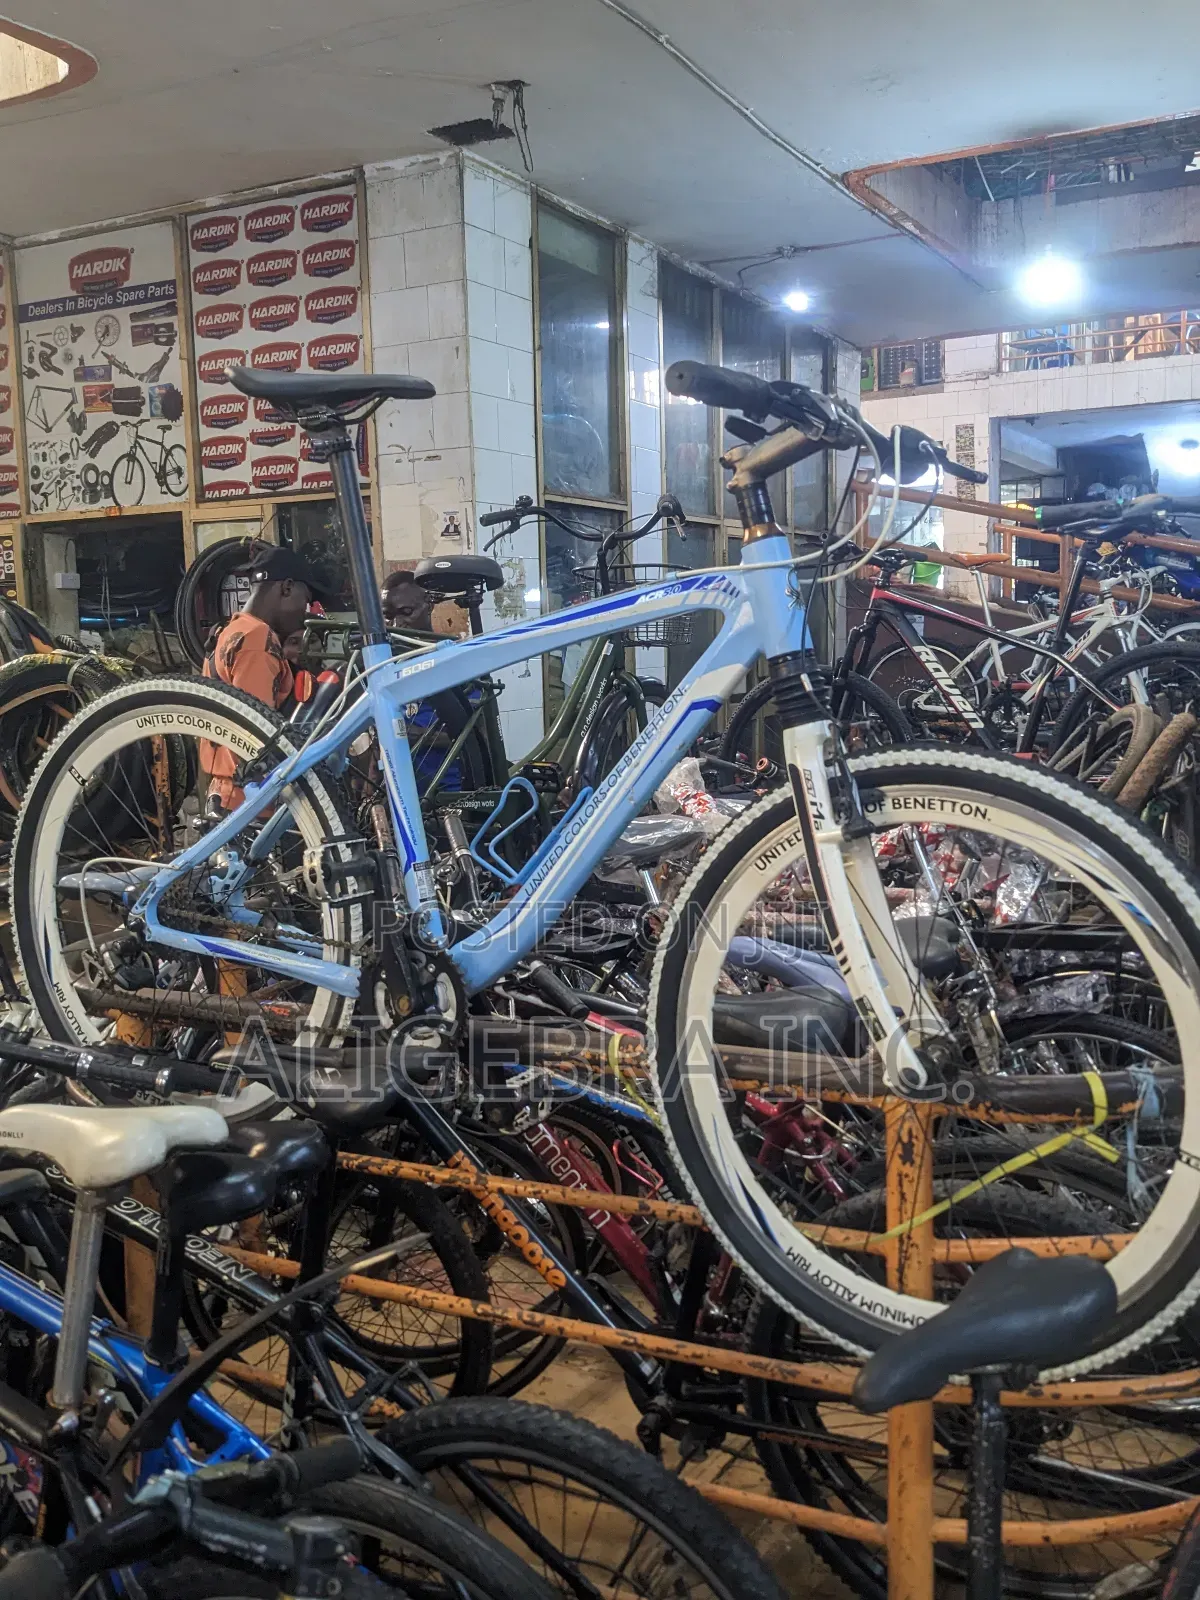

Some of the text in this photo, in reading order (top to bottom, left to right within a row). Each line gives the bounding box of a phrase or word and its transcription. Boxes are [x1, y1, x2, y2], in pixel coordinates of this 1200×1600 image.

[303, 201, 350, 220] HARDIK
[246, 212, 292, 231] HARDIK
[192, 222, 236, 241] HARDIK
[306, 246, 352, 265] HARDIK
[72, 256, 127, 279] HARDIK
[249, 256, 295, 274] HARDIK
[195, 266, 238, 284] HARDIK
[28, 283, 175, 317] Dealers In Bicycle Spare Parts
[308, 293, 354, 311] HARDIK
[197, 310, 240, 327] HARDIK
[251, 302, 296, 319] HARDIK
[254, 349, 299, 365] HARDIK
[310, 341, 356, 358] HARDIK
[200, 356, 243, 372] HARDIK
[203, 401, 246, 417] HARDIK
[201, 443, 244, 457] HARDIK
[0, 471, 19, 482] RDIK
[252, 463, 296, 477] HARDIK
[136, 714, 258, 758] UNITED COLOR OF BENE
[754, 797, 992, 872] UNITED OF BENETTON.
[53, 981, 85, 1036] ALLOY RIM
[446, 1149, 568, 1292] mngoose
[785, 1246, 928, 1326] UMINUM ALLOY RIM
